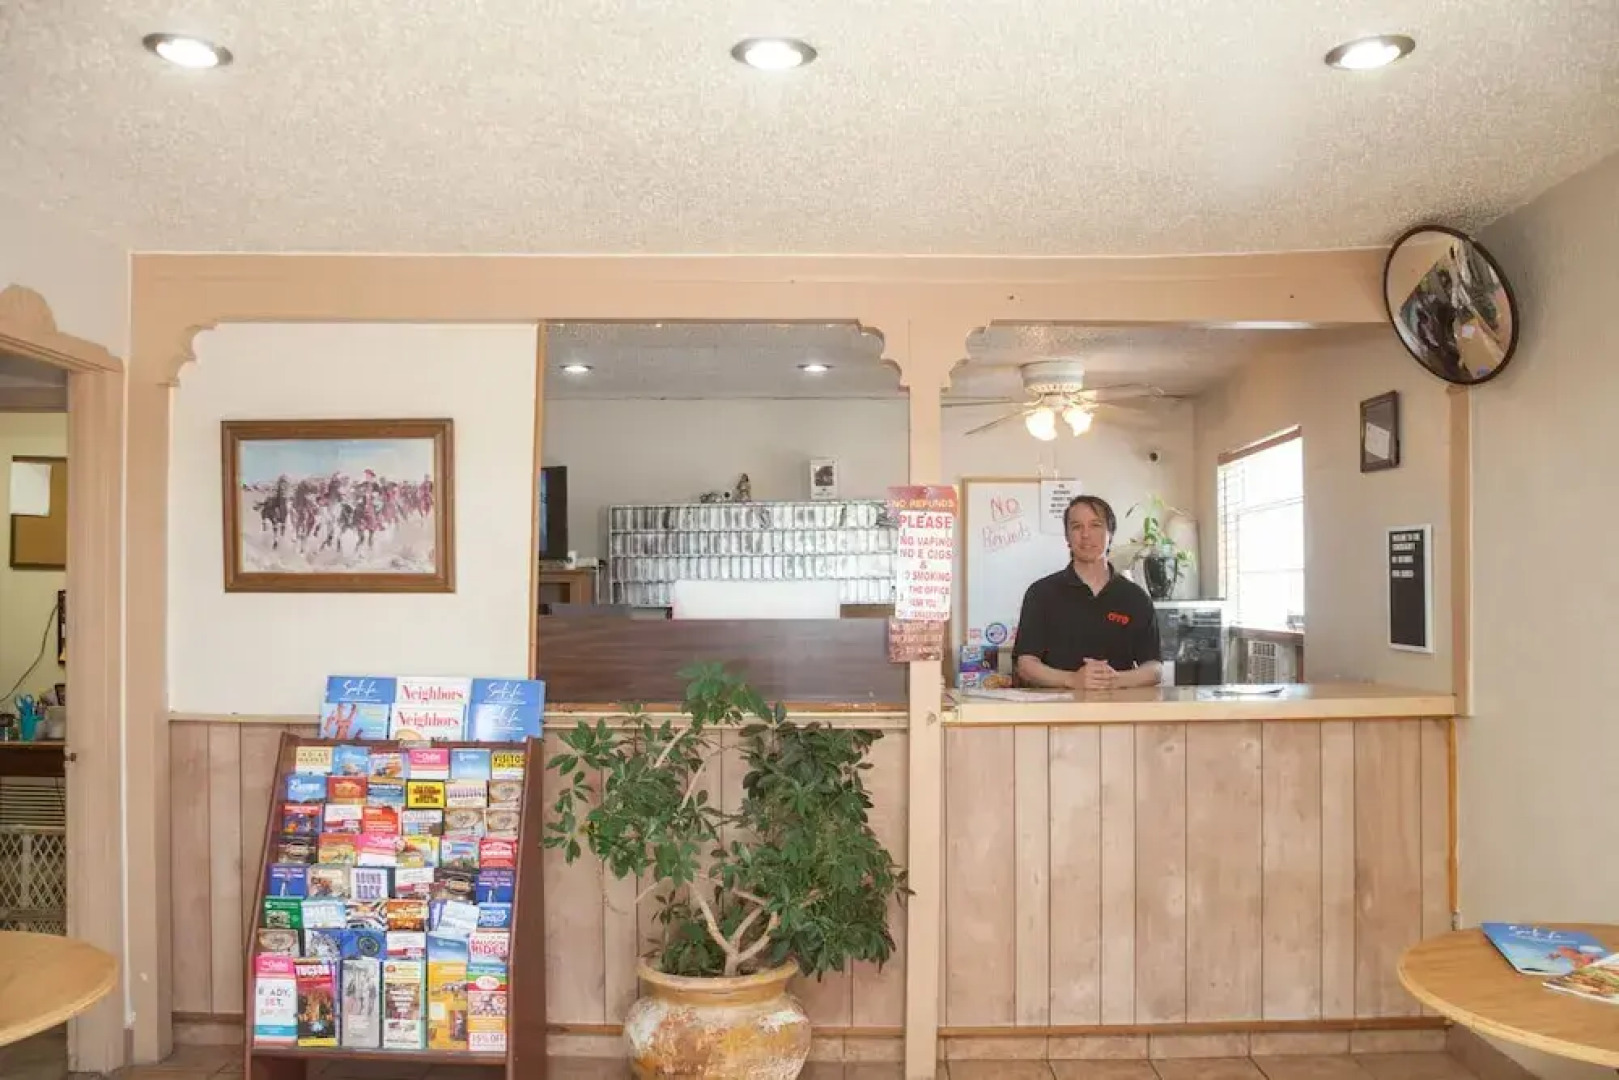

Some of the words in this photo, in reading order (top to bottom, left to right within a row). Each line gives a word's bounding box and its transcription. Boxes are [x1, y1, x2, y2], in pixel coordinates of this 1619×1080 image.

[991, 496, 1019, 520] NO
[899, 515, 952, 528] PLEASE
[900, 536, 913, 545] NO
[918, 536, 953, 547] VAPING
[900, 549, 913, 558] NO
[918, 549, 923, 558] E
[928, 549, 952, 559] CIGS
[919, 561, 927, 569] &
[912, 570, 952, 581] SMOKING
[924, 585, 949, 595] OFFICE
[402, 685, 463, 701] Neighbors
[397, 711, 459, 728] Neighbors
[470, 944, 506, 955] RIDES
